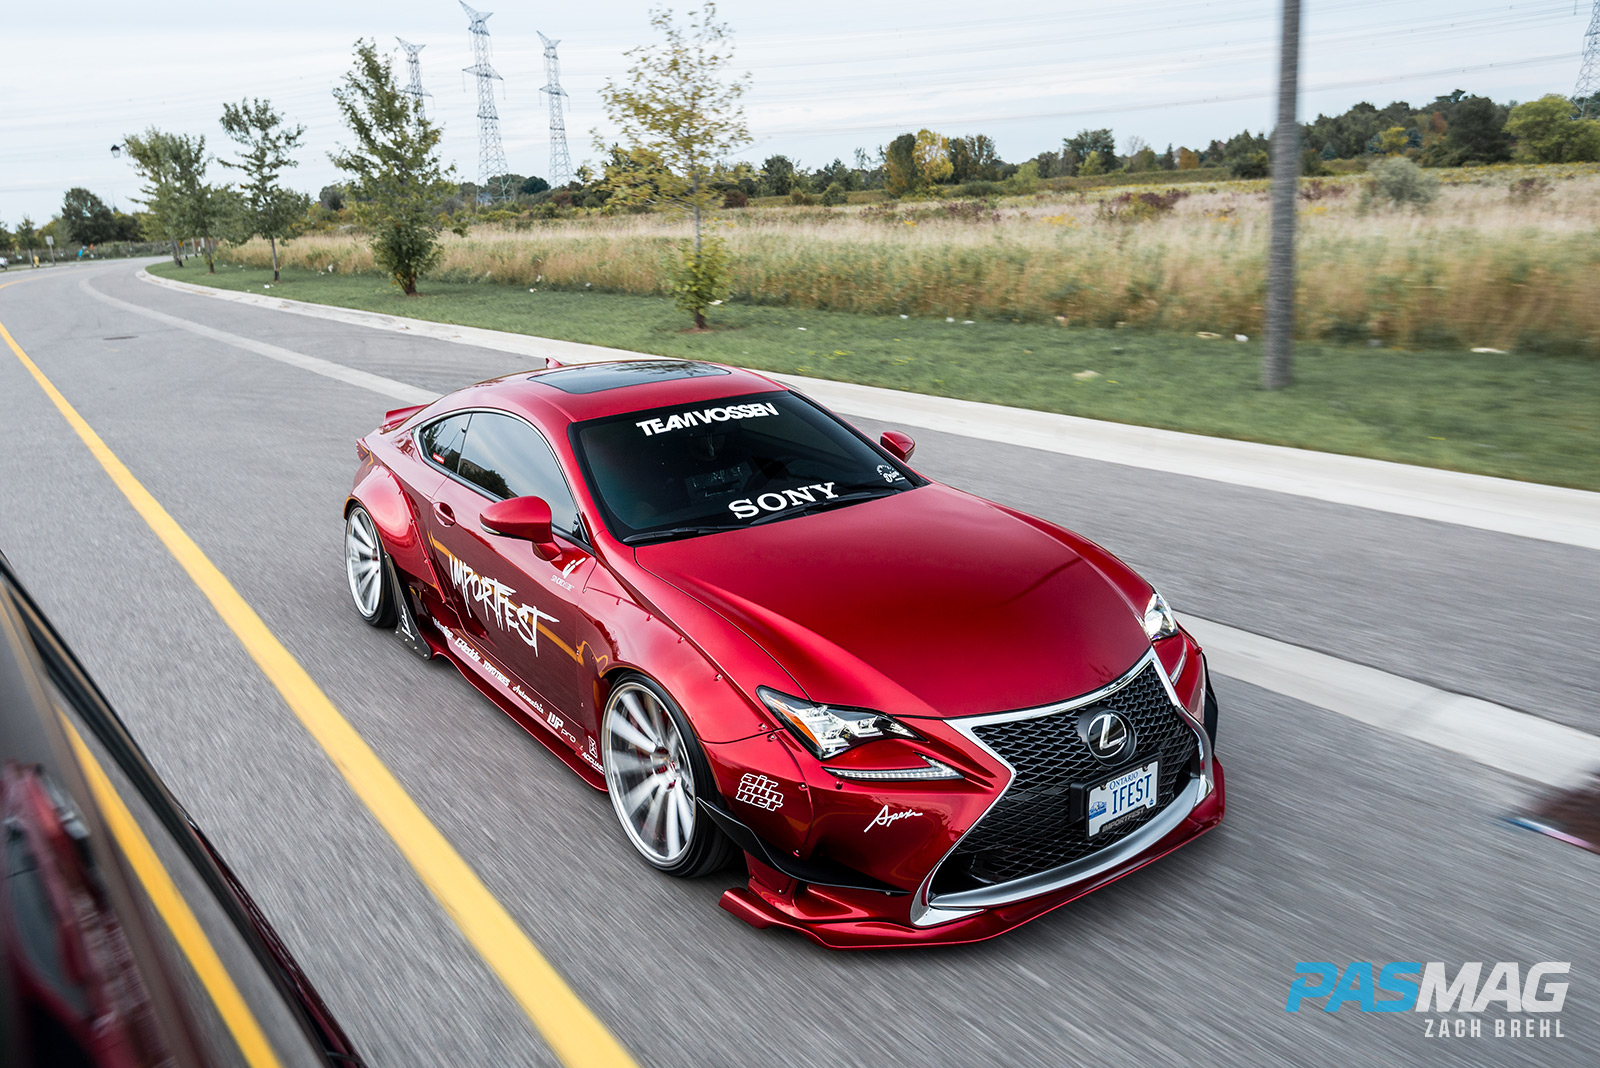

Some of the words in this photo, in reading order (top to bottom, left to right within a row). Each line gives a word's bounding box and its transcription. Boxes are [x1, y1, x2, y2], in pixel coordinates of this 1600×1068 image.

[728, 482, 839, 519] SONY
[449, 554, 560, 657] IMPORTFEST
[1109, 771, 1139, 791] ONTARIO
[1111, 773, 1152, 815] IFEST
